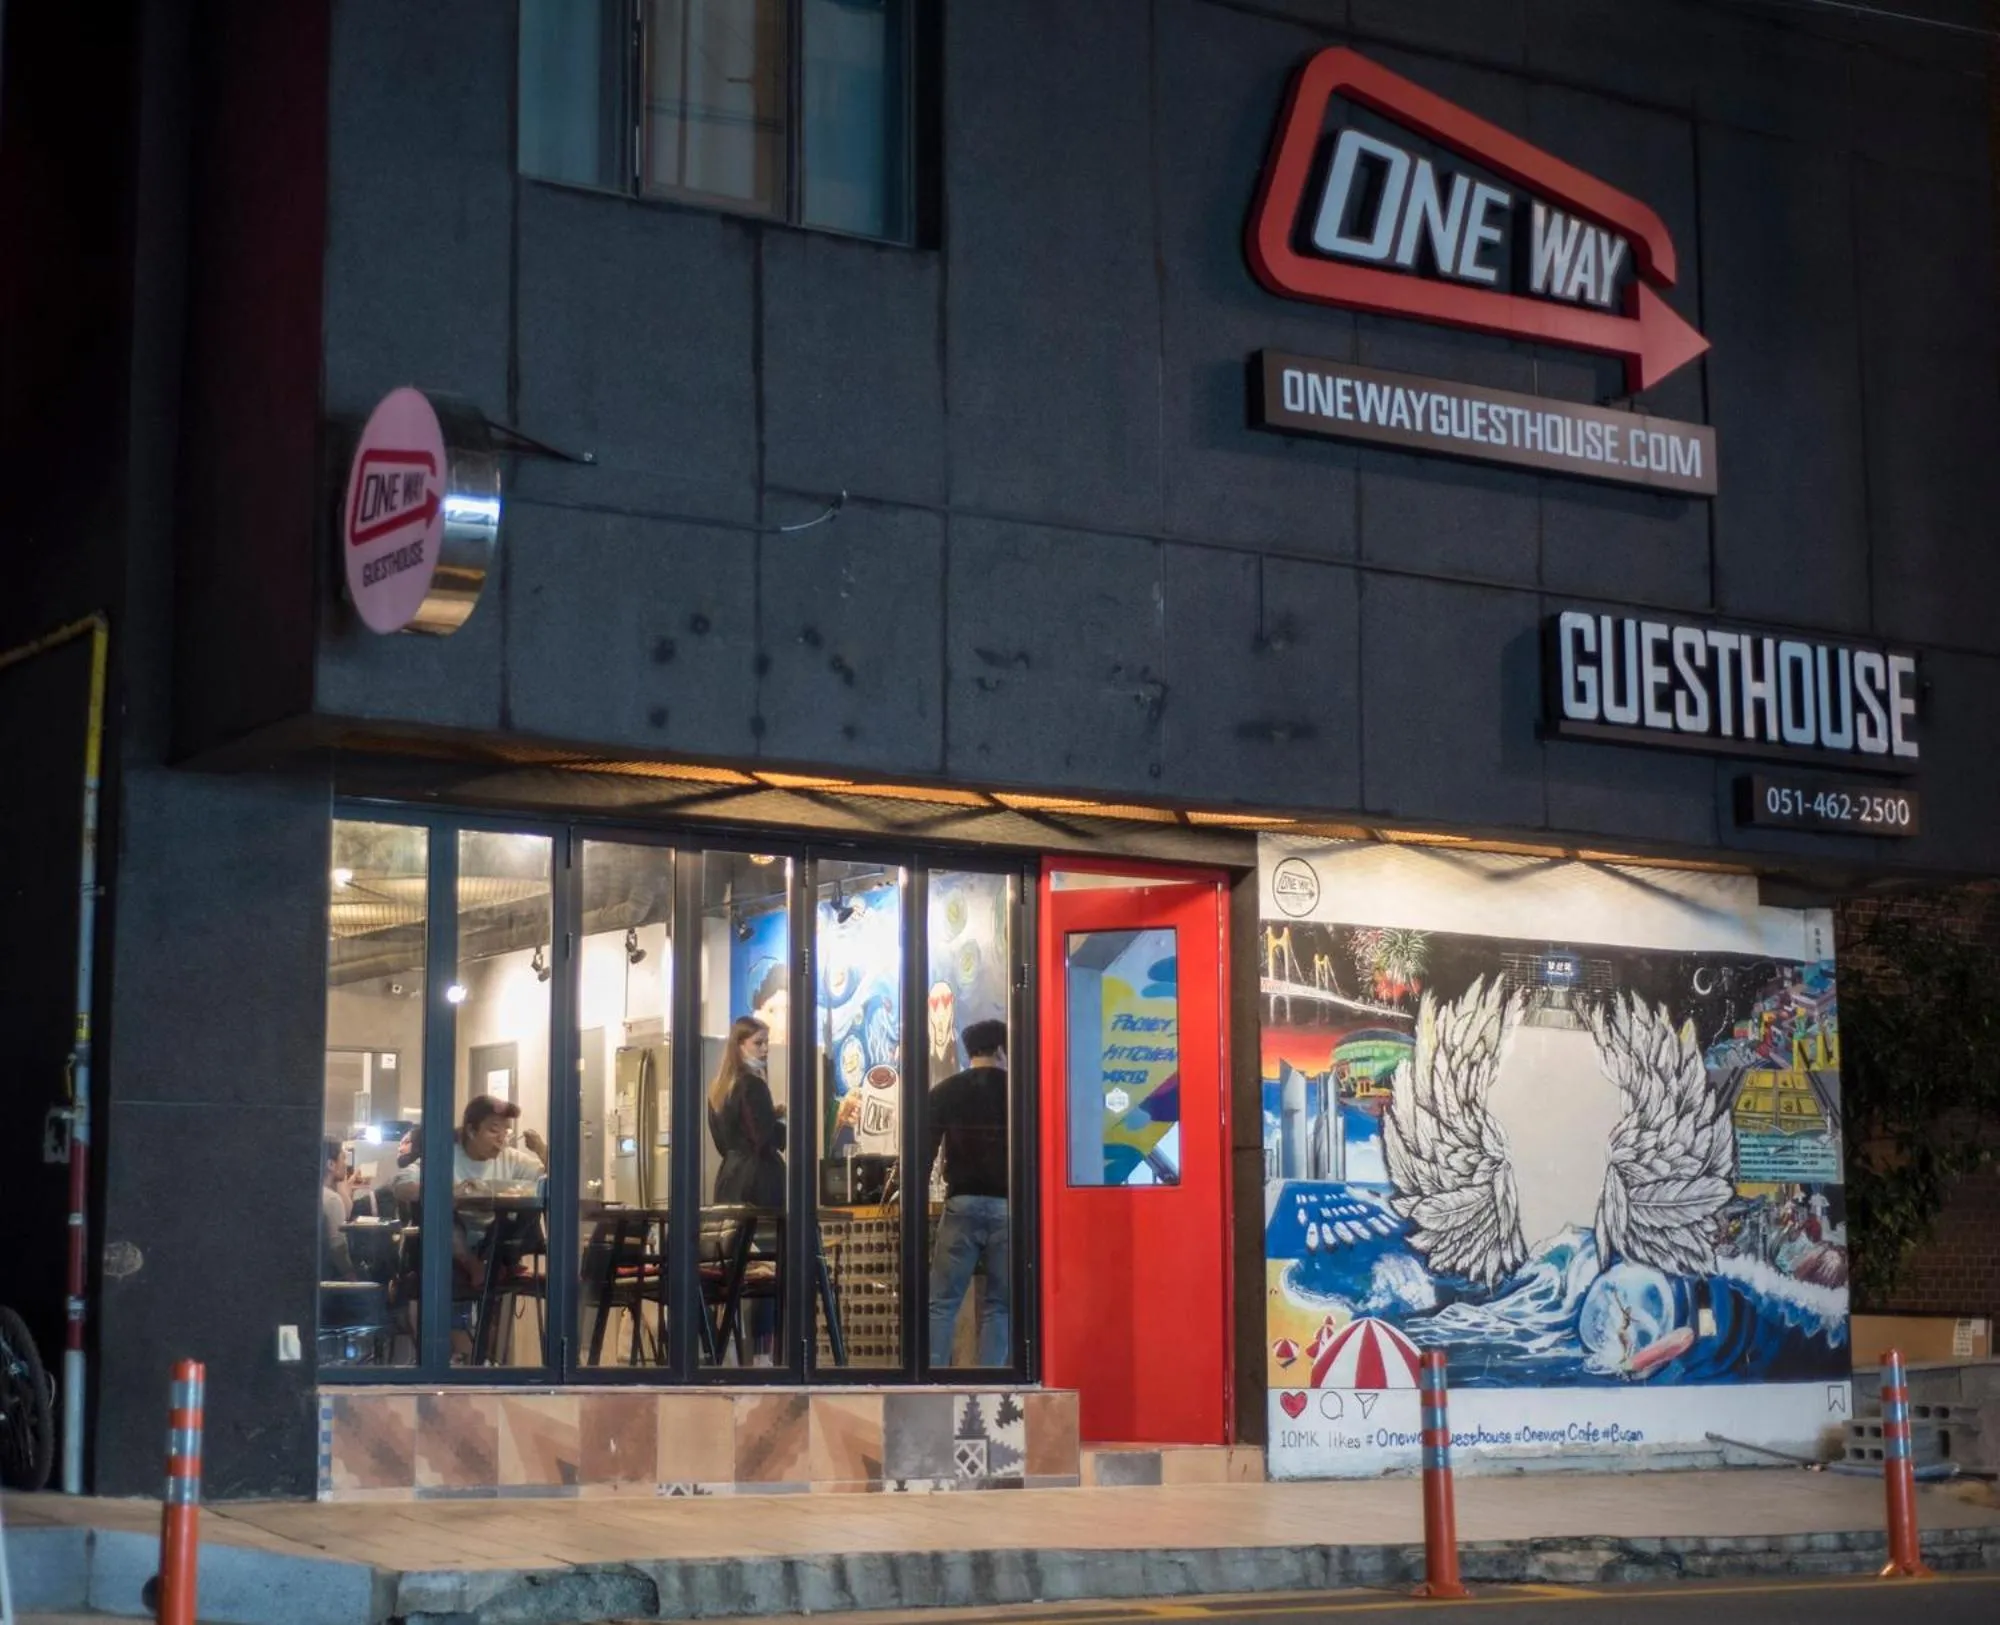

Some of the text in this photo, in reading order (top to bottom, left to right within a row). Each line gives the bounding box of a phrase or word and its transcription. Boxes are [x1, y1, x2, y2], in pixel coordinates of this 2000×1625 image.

[1312, 128, 1628, 308] ONE WAY
[1283, 368, 1703, 479] ONEWAYGUESTHOUSE.COM
[360, 473, 401, 523] ONE
[362, 538, 425, 588] GUESTHOUSE
[1558, 610, 1919, 758] GUESTHOUSE
[1766, 785, 1911, 826] 051-462-2500
[1328, 1431, 1361, 1448] likes
